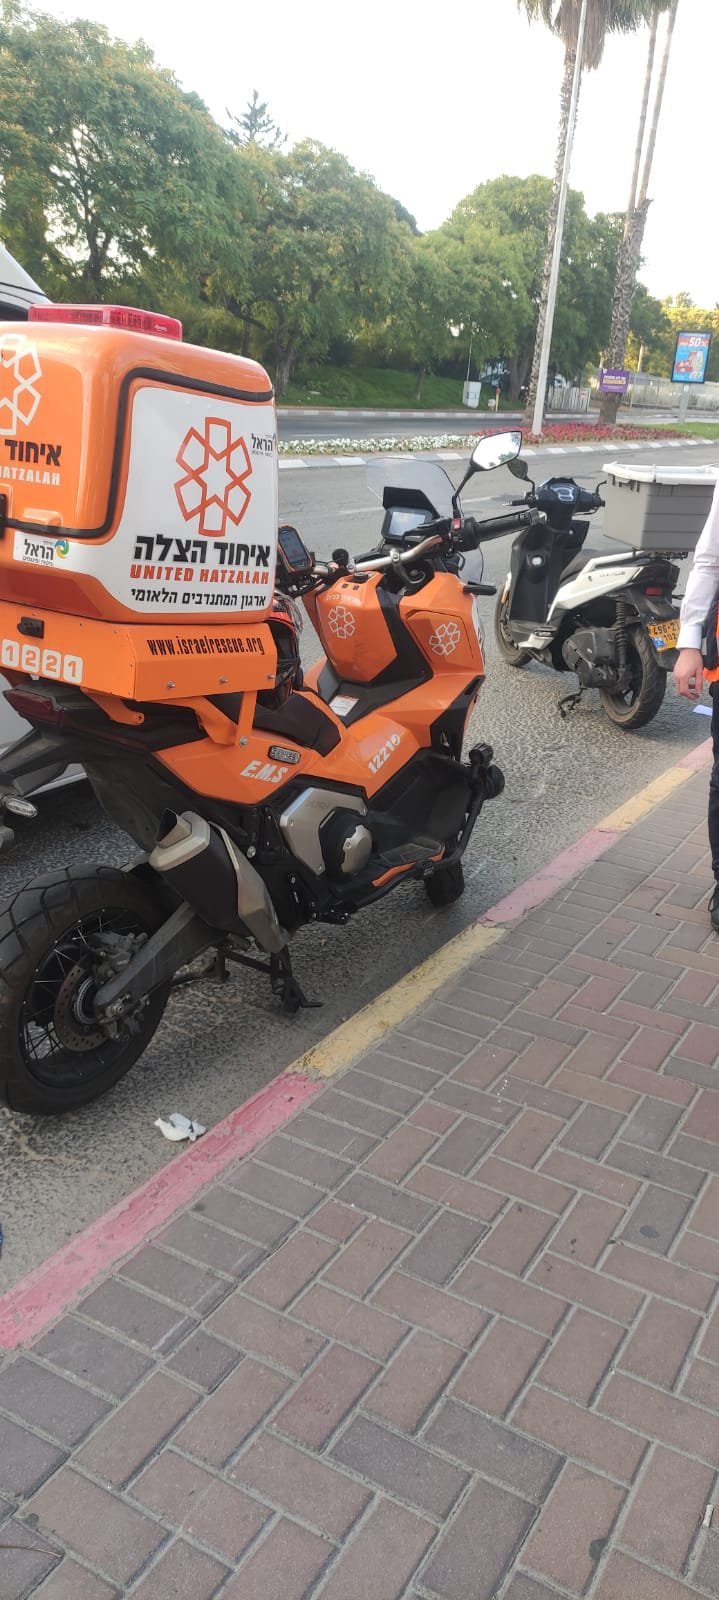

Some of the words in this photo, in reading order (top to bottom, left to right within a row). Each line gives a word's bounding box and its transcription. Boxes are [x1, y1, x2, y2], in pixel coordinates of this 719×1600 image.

[251, 433, 273, 451] הראל
[4, 439, 62, 467] איחוד
[24, 538, 54, 561] הראל
[134, 534, 208, 563] הצלה
[213, 541, 271, 567] איחוד
[130, 564, 194, 582] UNITED
[199, 568, 269, 584] HATZALAH
[131, 587, 178, 604] הלאומי
[181, 592, 238, 606] המתנדבים
[240, 593, 267, 610] ארגון
[147, 635, 266, 656] www.israelrescue.org
[2, 641, 81, 682] 1221
